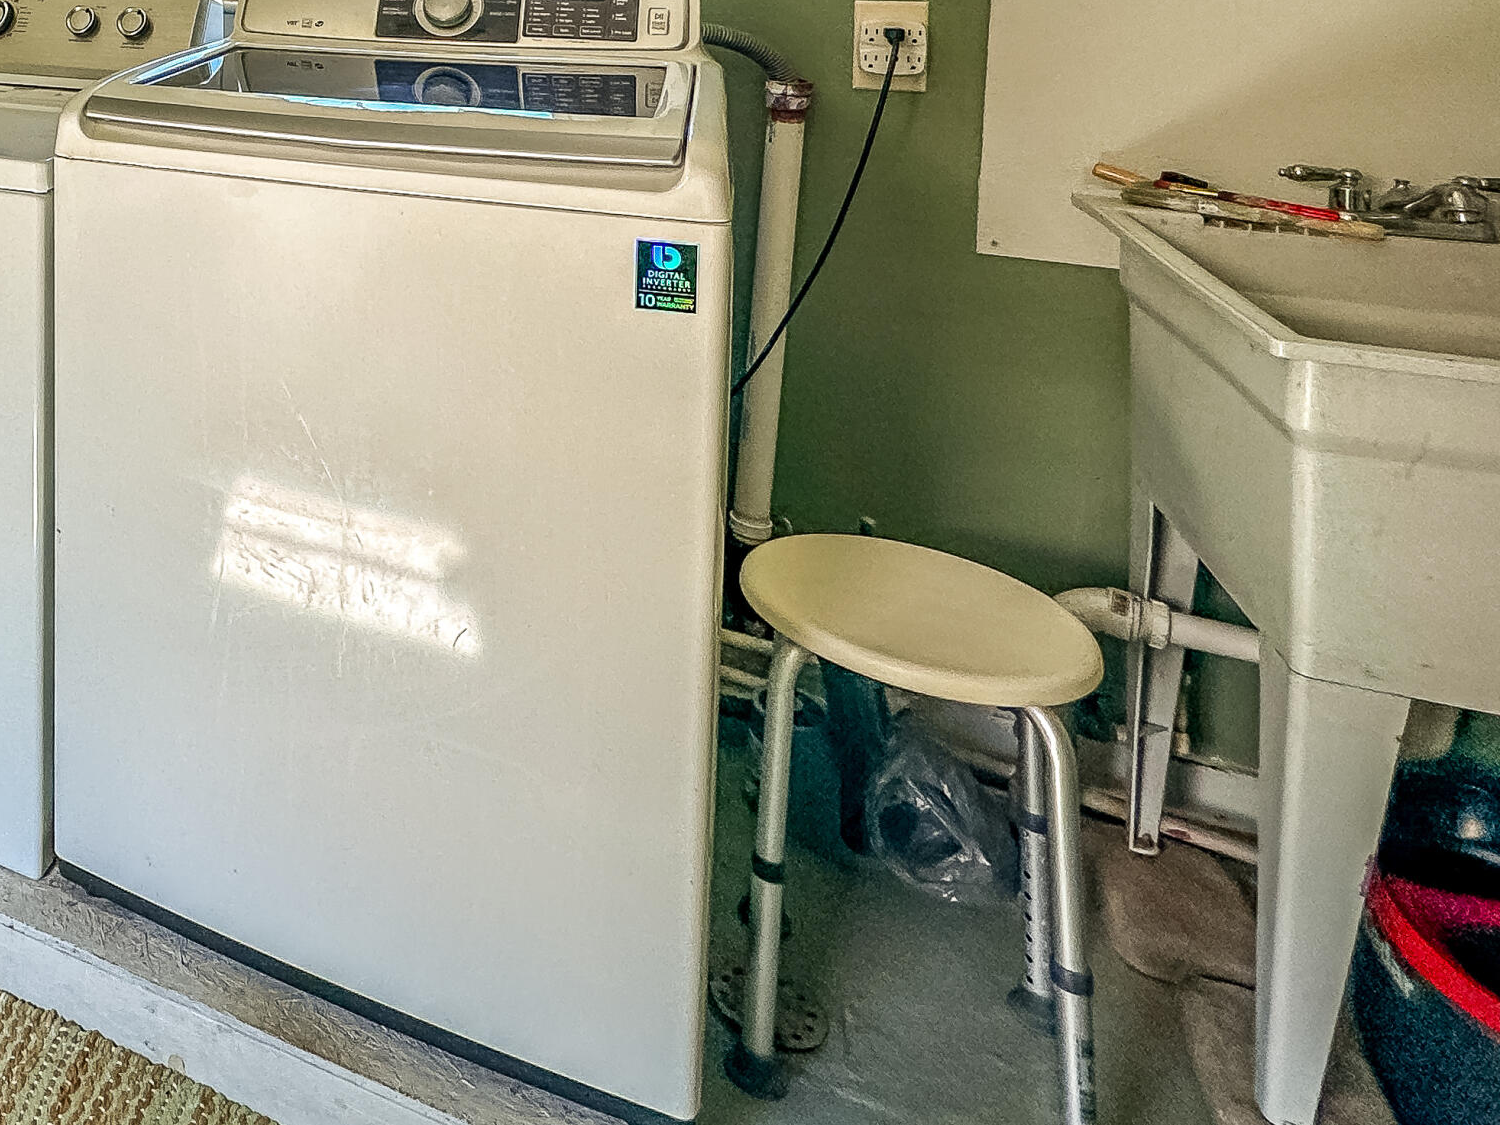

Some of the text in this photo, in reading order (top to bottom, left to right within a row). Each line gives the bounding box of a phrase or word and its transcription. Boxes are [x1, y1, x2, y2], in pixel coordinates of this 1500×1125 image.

[647, 269, 685, 280] DIGITAL
[642, 277, 691, 288] INVERTER
[638, 294, 655, 307] 10
